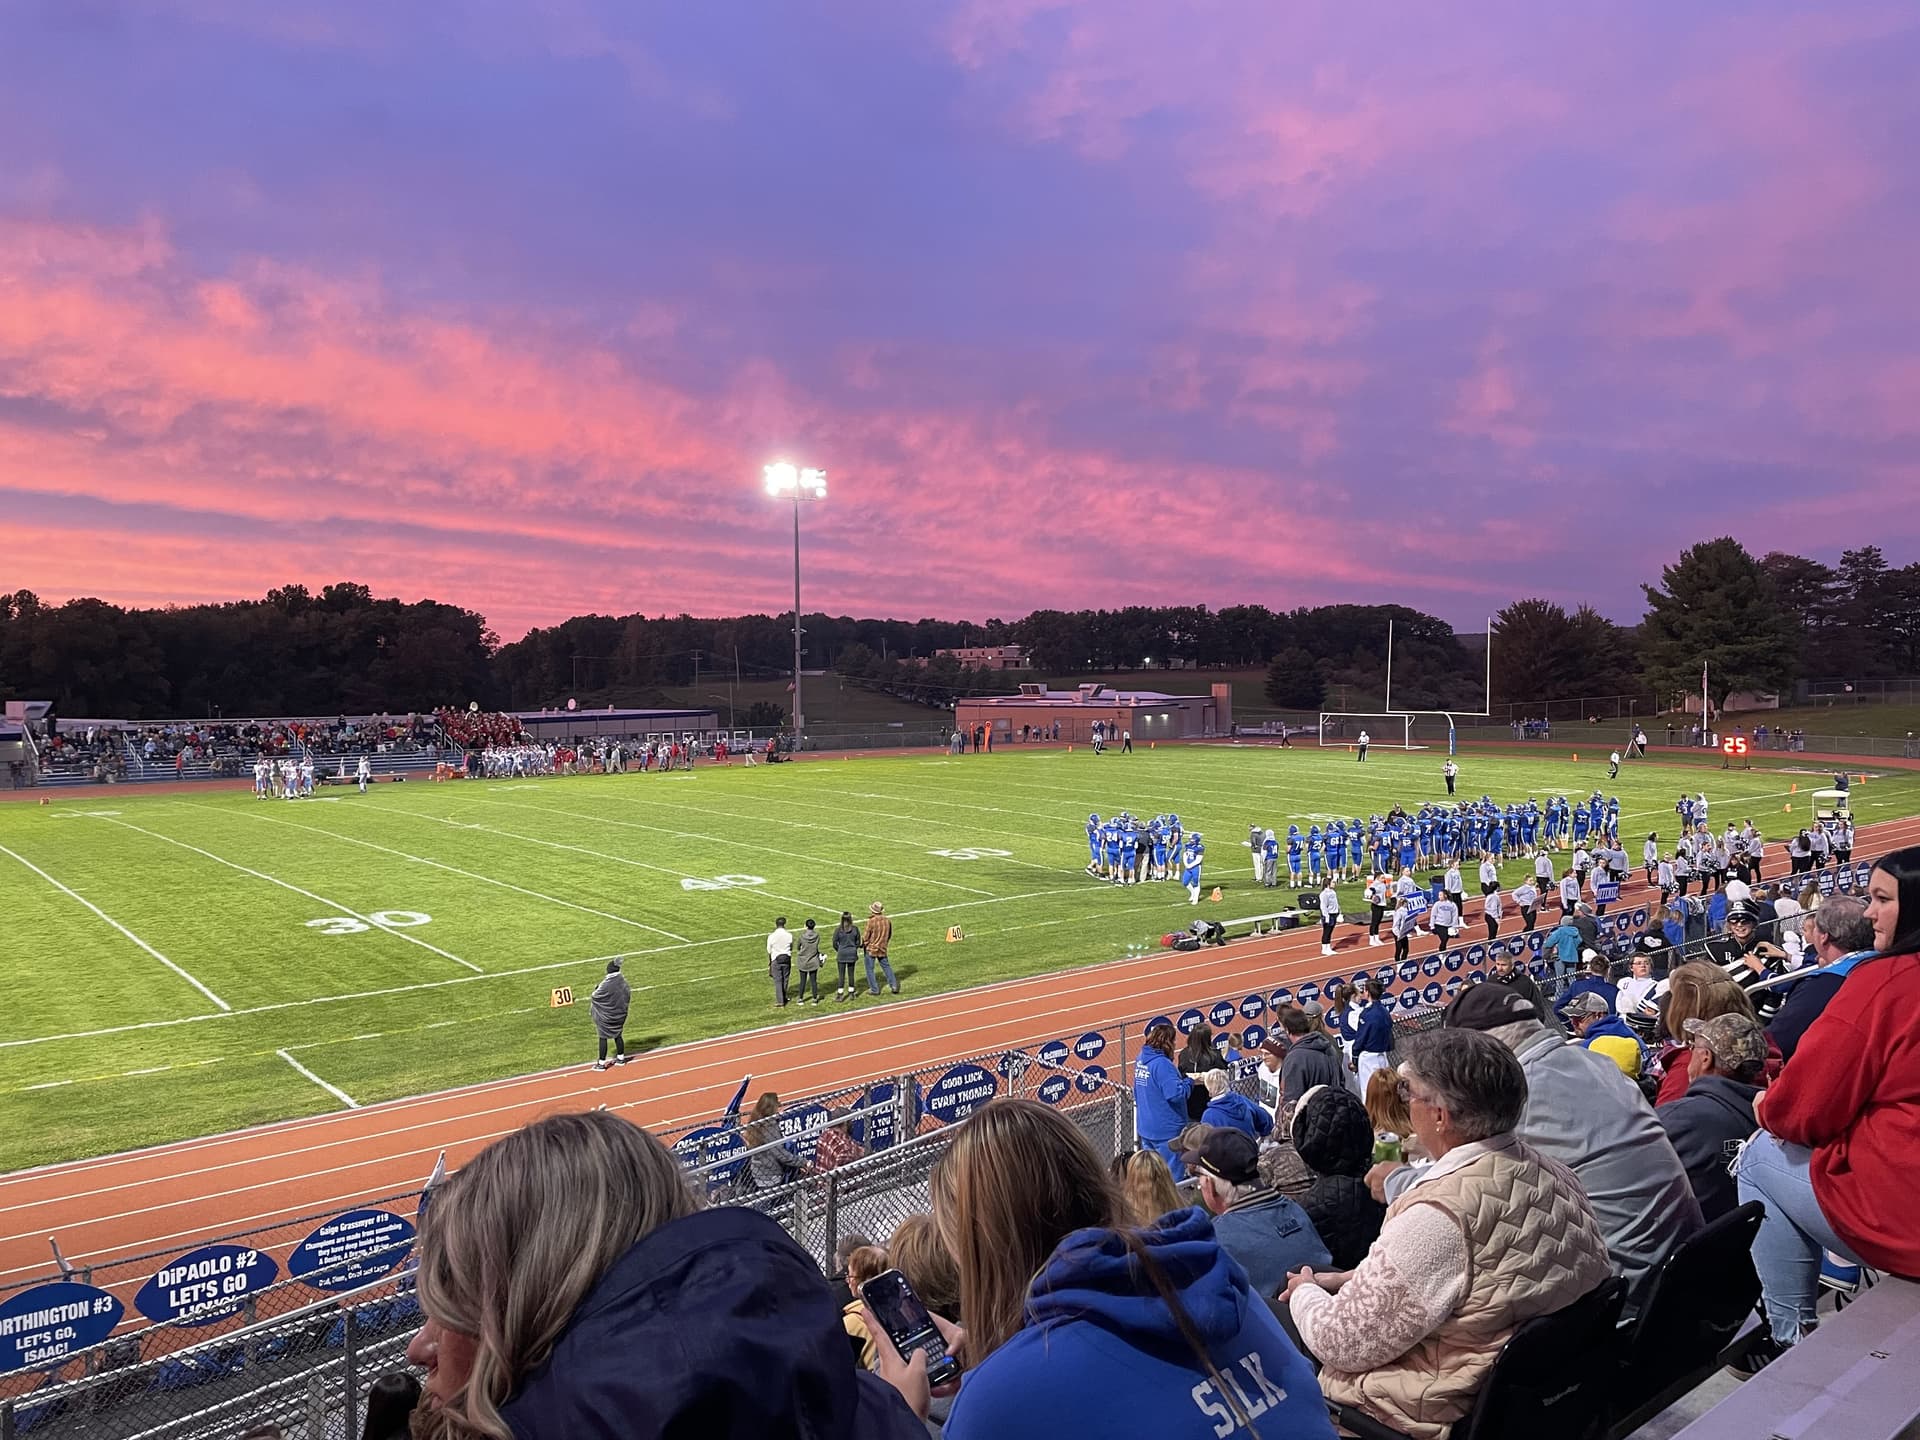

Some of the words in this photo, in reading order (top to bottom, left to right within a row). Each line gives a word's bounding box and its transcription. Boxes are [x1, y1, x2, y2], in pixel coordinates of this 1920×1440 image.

[1723, 736, 1747, 753] 25
[1106, 831, 1118, 842] 24
[1125, 836, 1133, 847] 2
[303, 910, 432, 935] 30
[952, 927, 962, 940] 40
[555, 988, 571, 1005] 30
[942, 1076, 963, 1090] GOOD
[964, 1070, 984, 1084] LUCK
[931, 1093, 956, 1110] EVAN
[957, 1083, 994, 1104] THOMAS
[805, 1110, 828, 1130] #20
[954, 1104, 973, 1118] #24
[376, 1213, 390, 1224] #19
[305, 1238, 336, 1251] Champions
[375, 1223, 403, 1235] something
[158, 1255, 231, 1288] DiPAOLO
[235, 1250, 258, 1270] #2
[169, 1280, 218, 1308] LET'S
[222, 1273, 247, 1295] GO
[93, 1295, 113, 1315] #3
[16, 1331, 52, 1351] LET'S
[55, 1326, 77, 1340] GO,
[24, 1342, 69, 1363] ISAAC!
